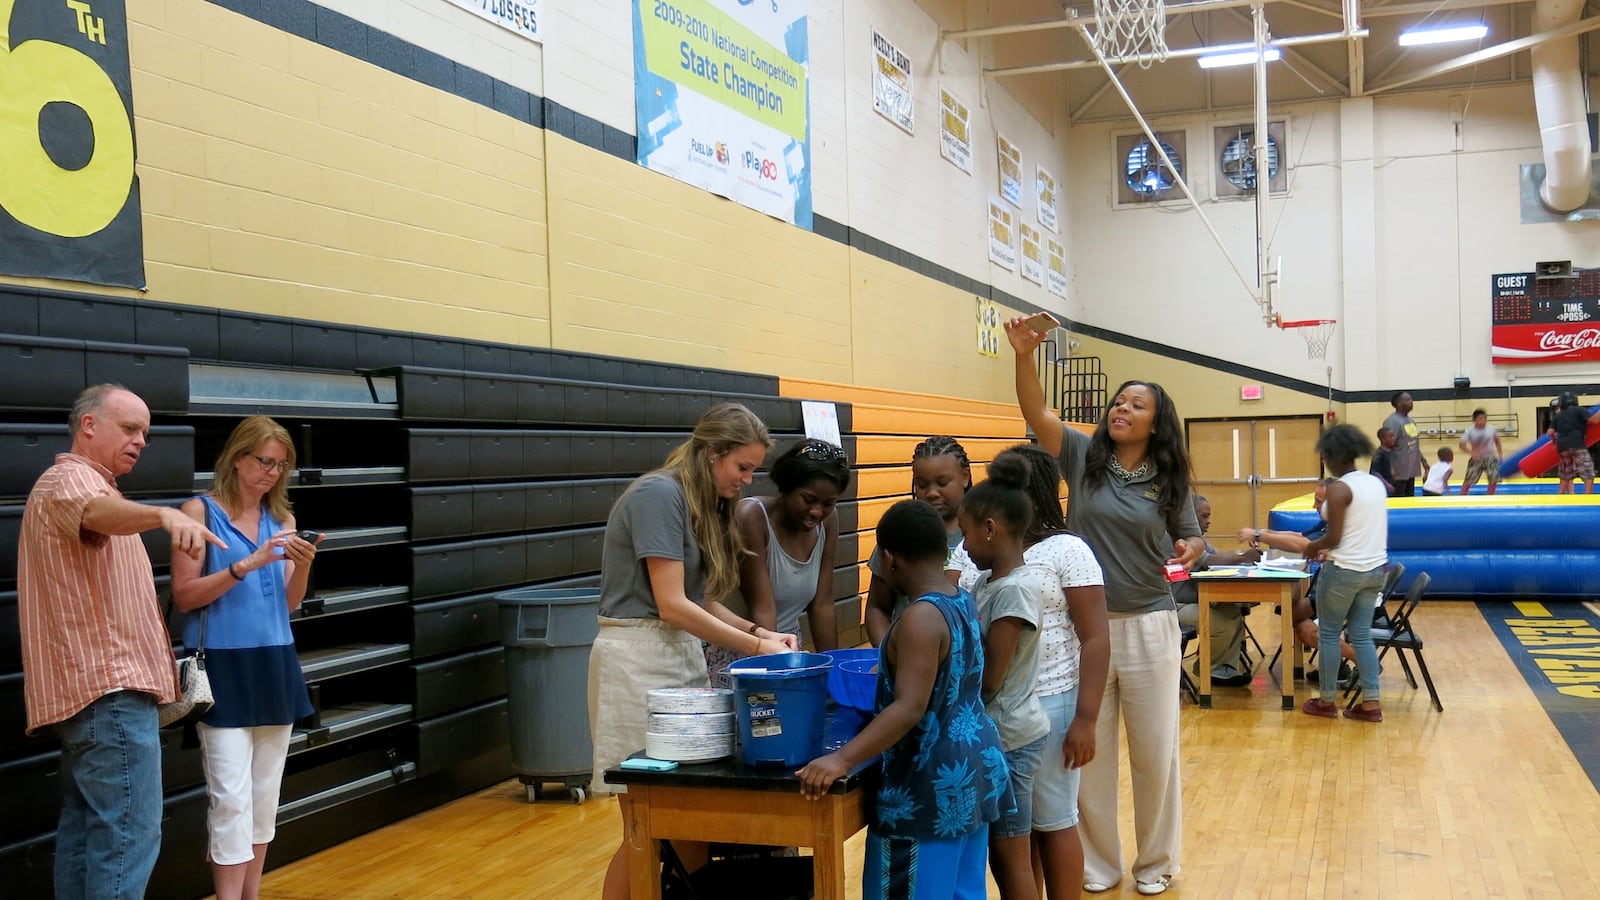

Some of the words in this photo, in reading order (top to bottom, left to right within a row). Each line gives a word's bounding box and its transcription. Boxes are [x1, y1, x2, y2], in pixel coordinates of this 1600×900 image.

[66, 0, 107, 45] TH
[491, 0, 537, 33] LOSSES
[654, 0, 709, 43] 2009-2010
[711, 27, 749, 64] National
[750, 49, 798, 90] Competition
[680, 41, 719, 84] State
[723, 62, 784, 115] Champion
[0, 0, 135, 238] 6
[1497, 276, 1527, 288] GUEST
[1563, 303, 1584, 313] TIME
[1563, 312, 1584, 321] POSS
[751, 709, 776, 717] BUCKET
